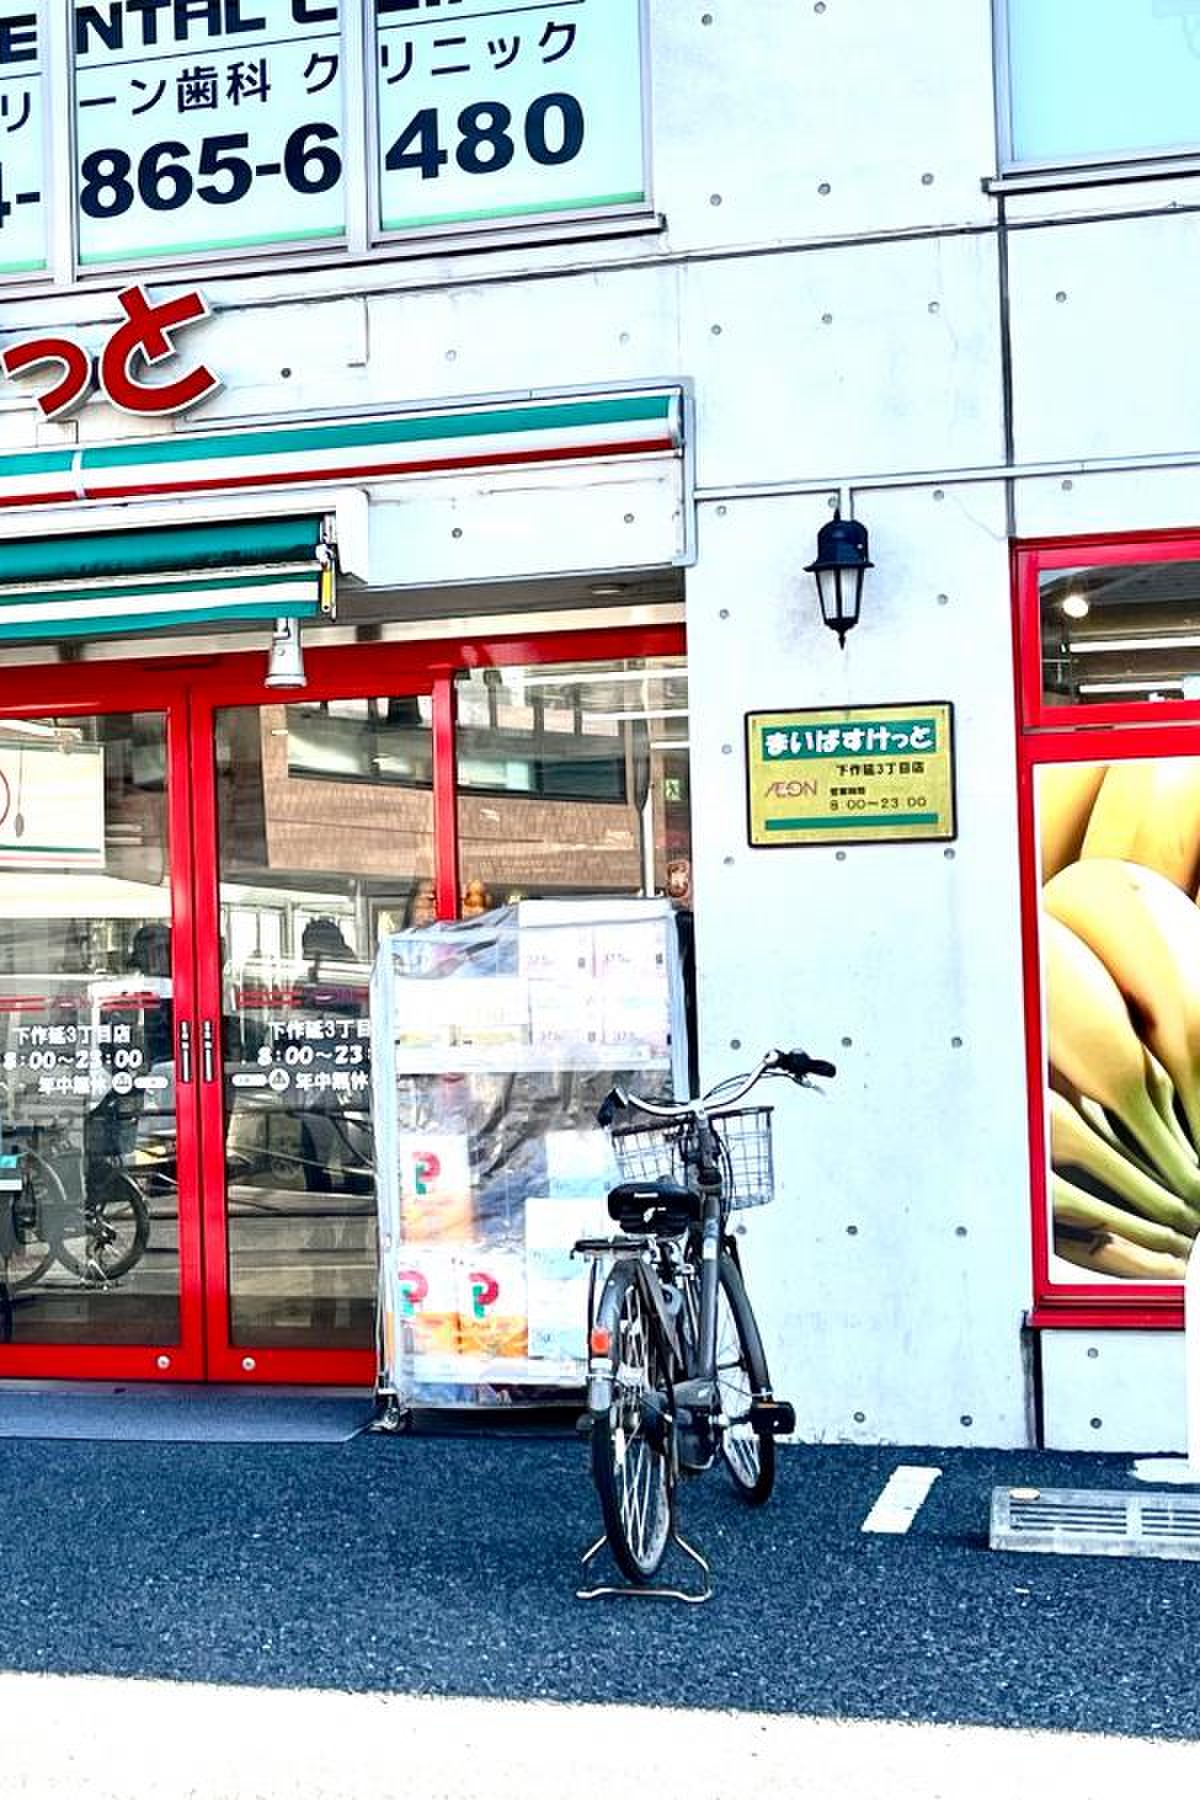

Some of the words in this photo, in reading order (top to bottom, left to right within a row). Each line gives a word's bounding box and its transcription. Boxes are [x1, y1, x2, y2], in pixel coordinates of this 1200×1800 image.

[303, 21, 577, 95] クリニック
[765, 725, 933, 756] まいばすけっと
[270, 1019, 371, 1041] 下作延3丁目
